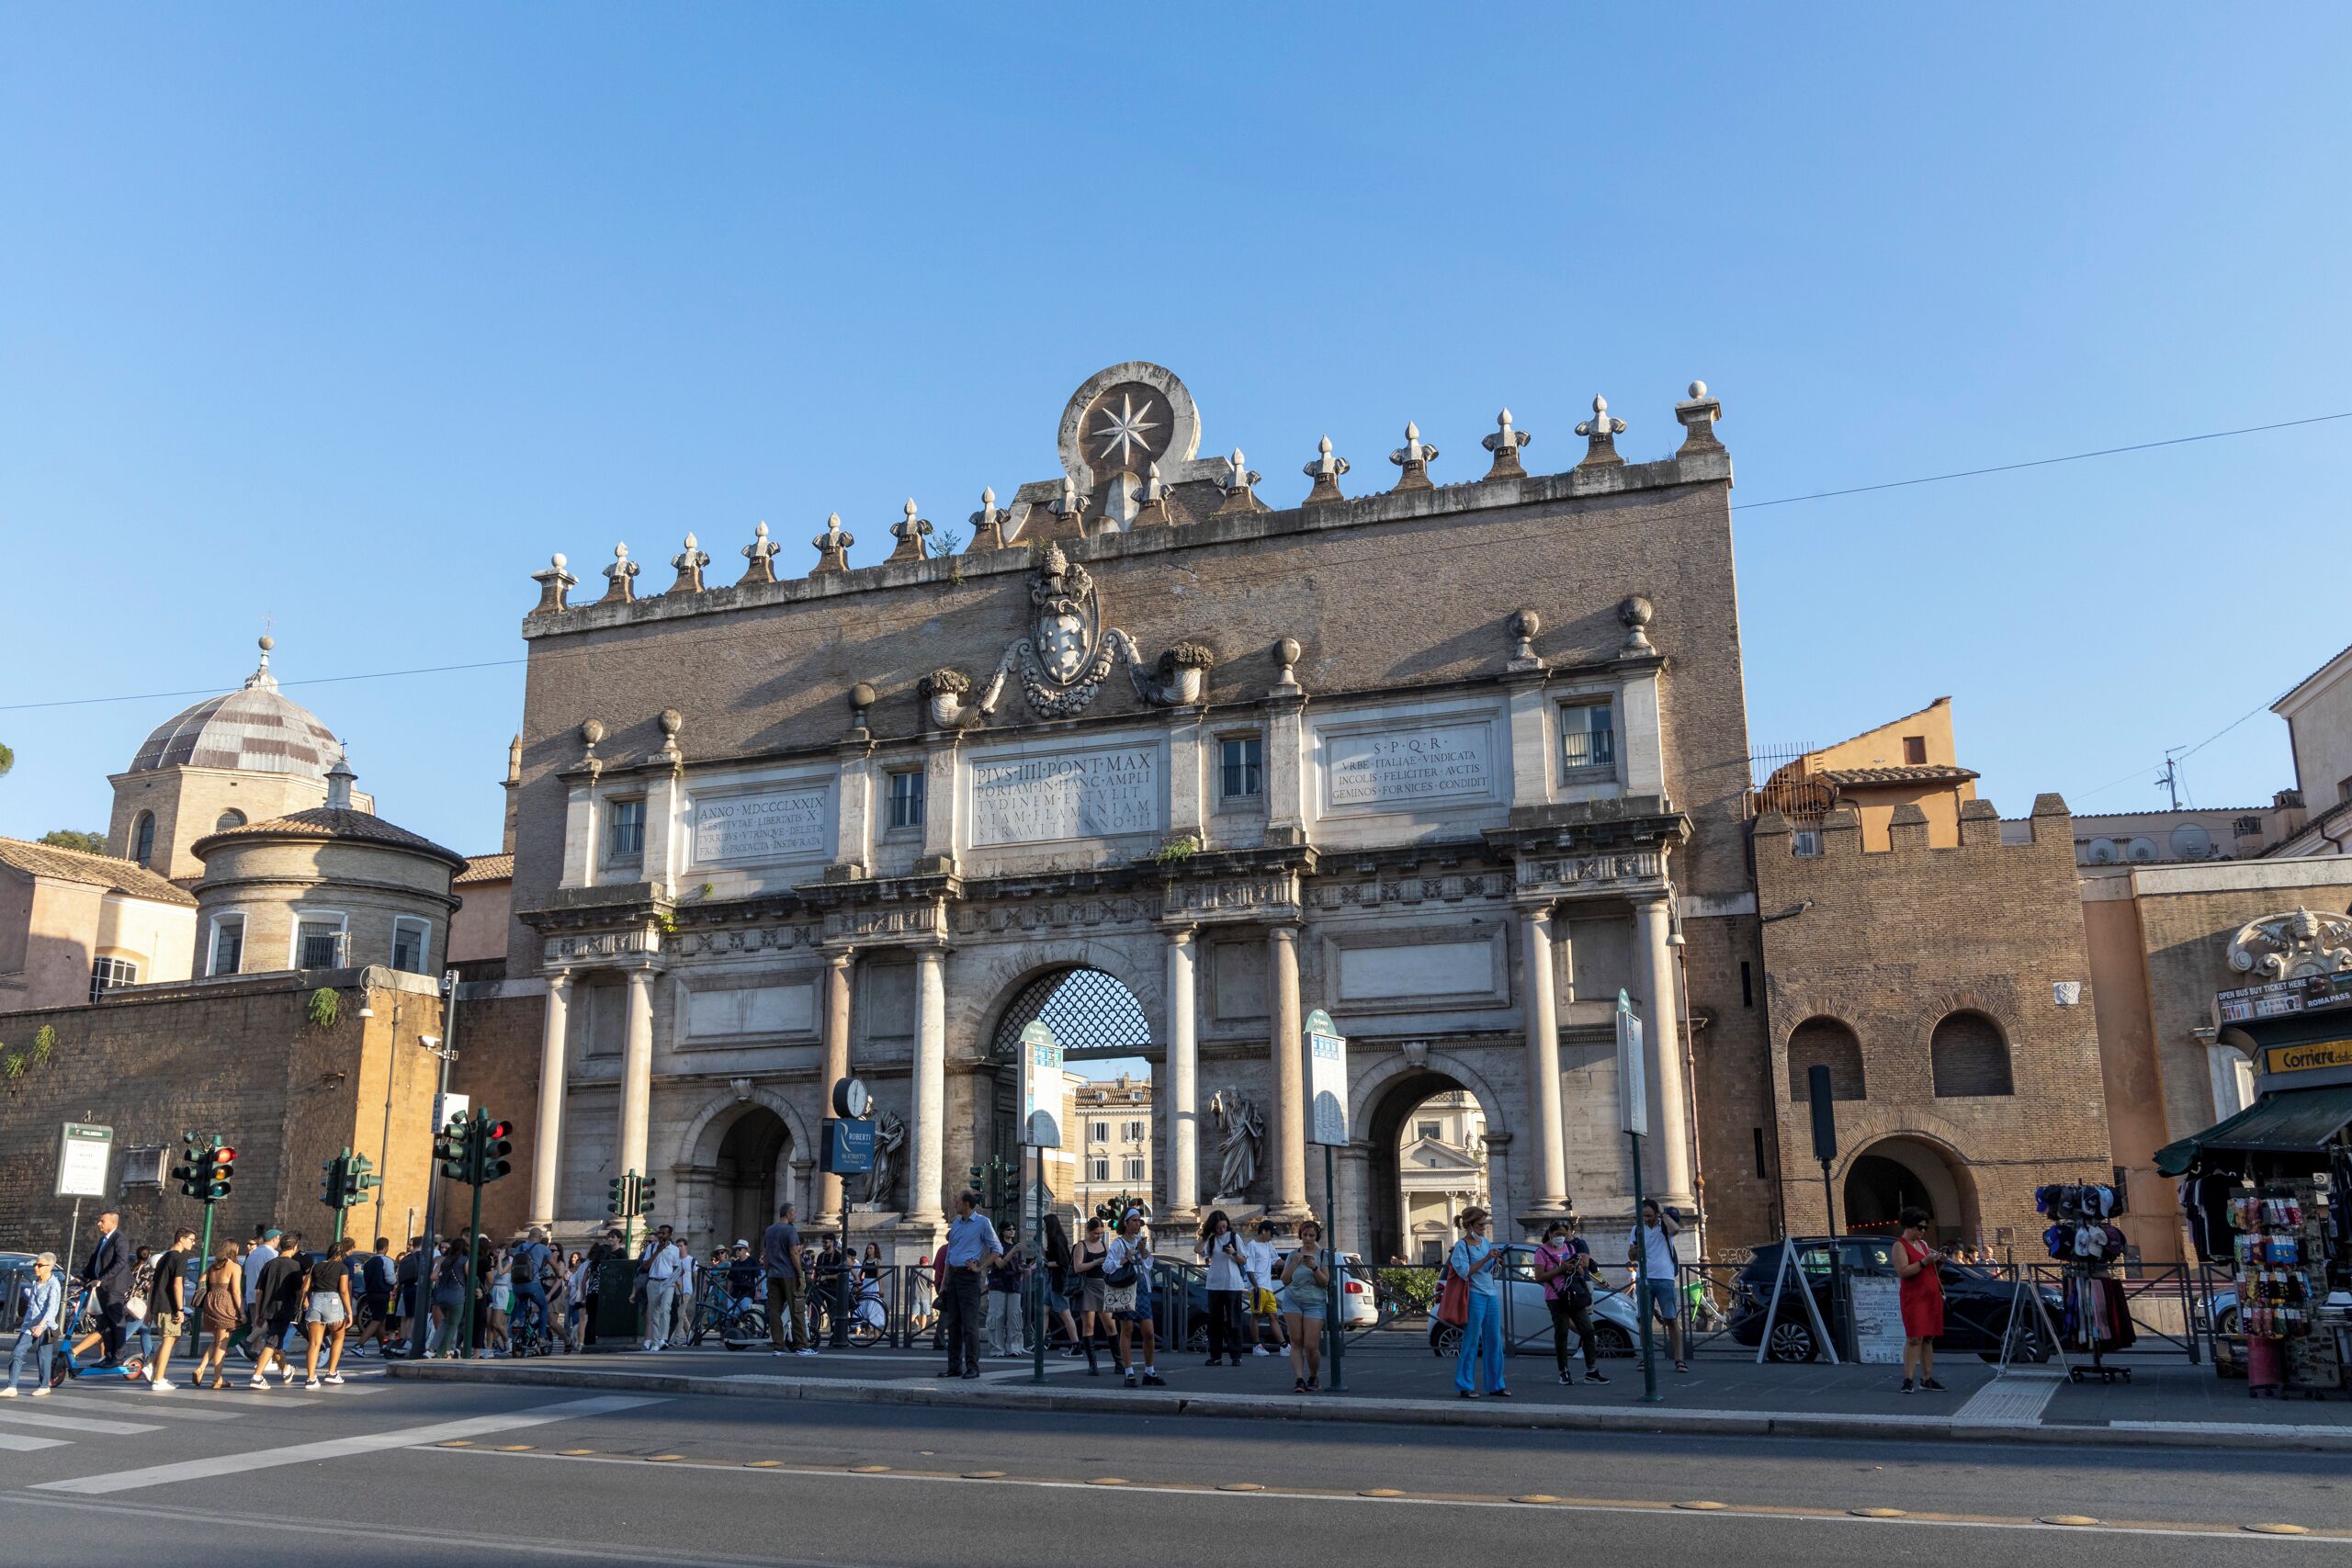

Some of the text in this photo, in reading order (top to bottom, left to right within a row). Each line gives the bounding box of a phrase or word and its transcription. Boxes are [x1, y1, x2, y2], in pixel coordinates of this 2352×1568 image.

[977, 766, 1012, 784] PIVS
[1047, 758, 1102, 776] PONT
[1107, 753, 1150, 773] MAX
[1342, 750, 1476, 771] VRBE ITALIAE VINDICATA
[1339, 763, 1480, 784] INCOLIS FELICITER AVCTIS
[978, 772, 1149, 797] PORTAM IN HANC AMPLI
[1333, 776, 1488, 799] GEMINOS FORNICES CONDIDIT
[700, 796, 823, 820] ANNO MDCCCLXXIX
[978, 800, 1148, 825] VIAM FLAMINIAM
[701, 818, 752, 831] RESTITVTAE
[758, 814, 802, 827] LIBERTATIS
[742, 827, 784, 839] VTRINQVE
[790, 824, 823, 834] DELETIS
[978, 822, 1057, 840] STRAVIT
[1071, 816, 1124, 832] ANNO
[729, 841, 769, 853] PRODVCTA
[2219, 978, 2307, 1000] OPEN BUS BUY TICKET HERE
[2307, 992, 2350, 1008] ROMA PASS
[2283, 1049, 2335, 1068] Corriere
[849, 1133, 871, 1141] ROBERTI
